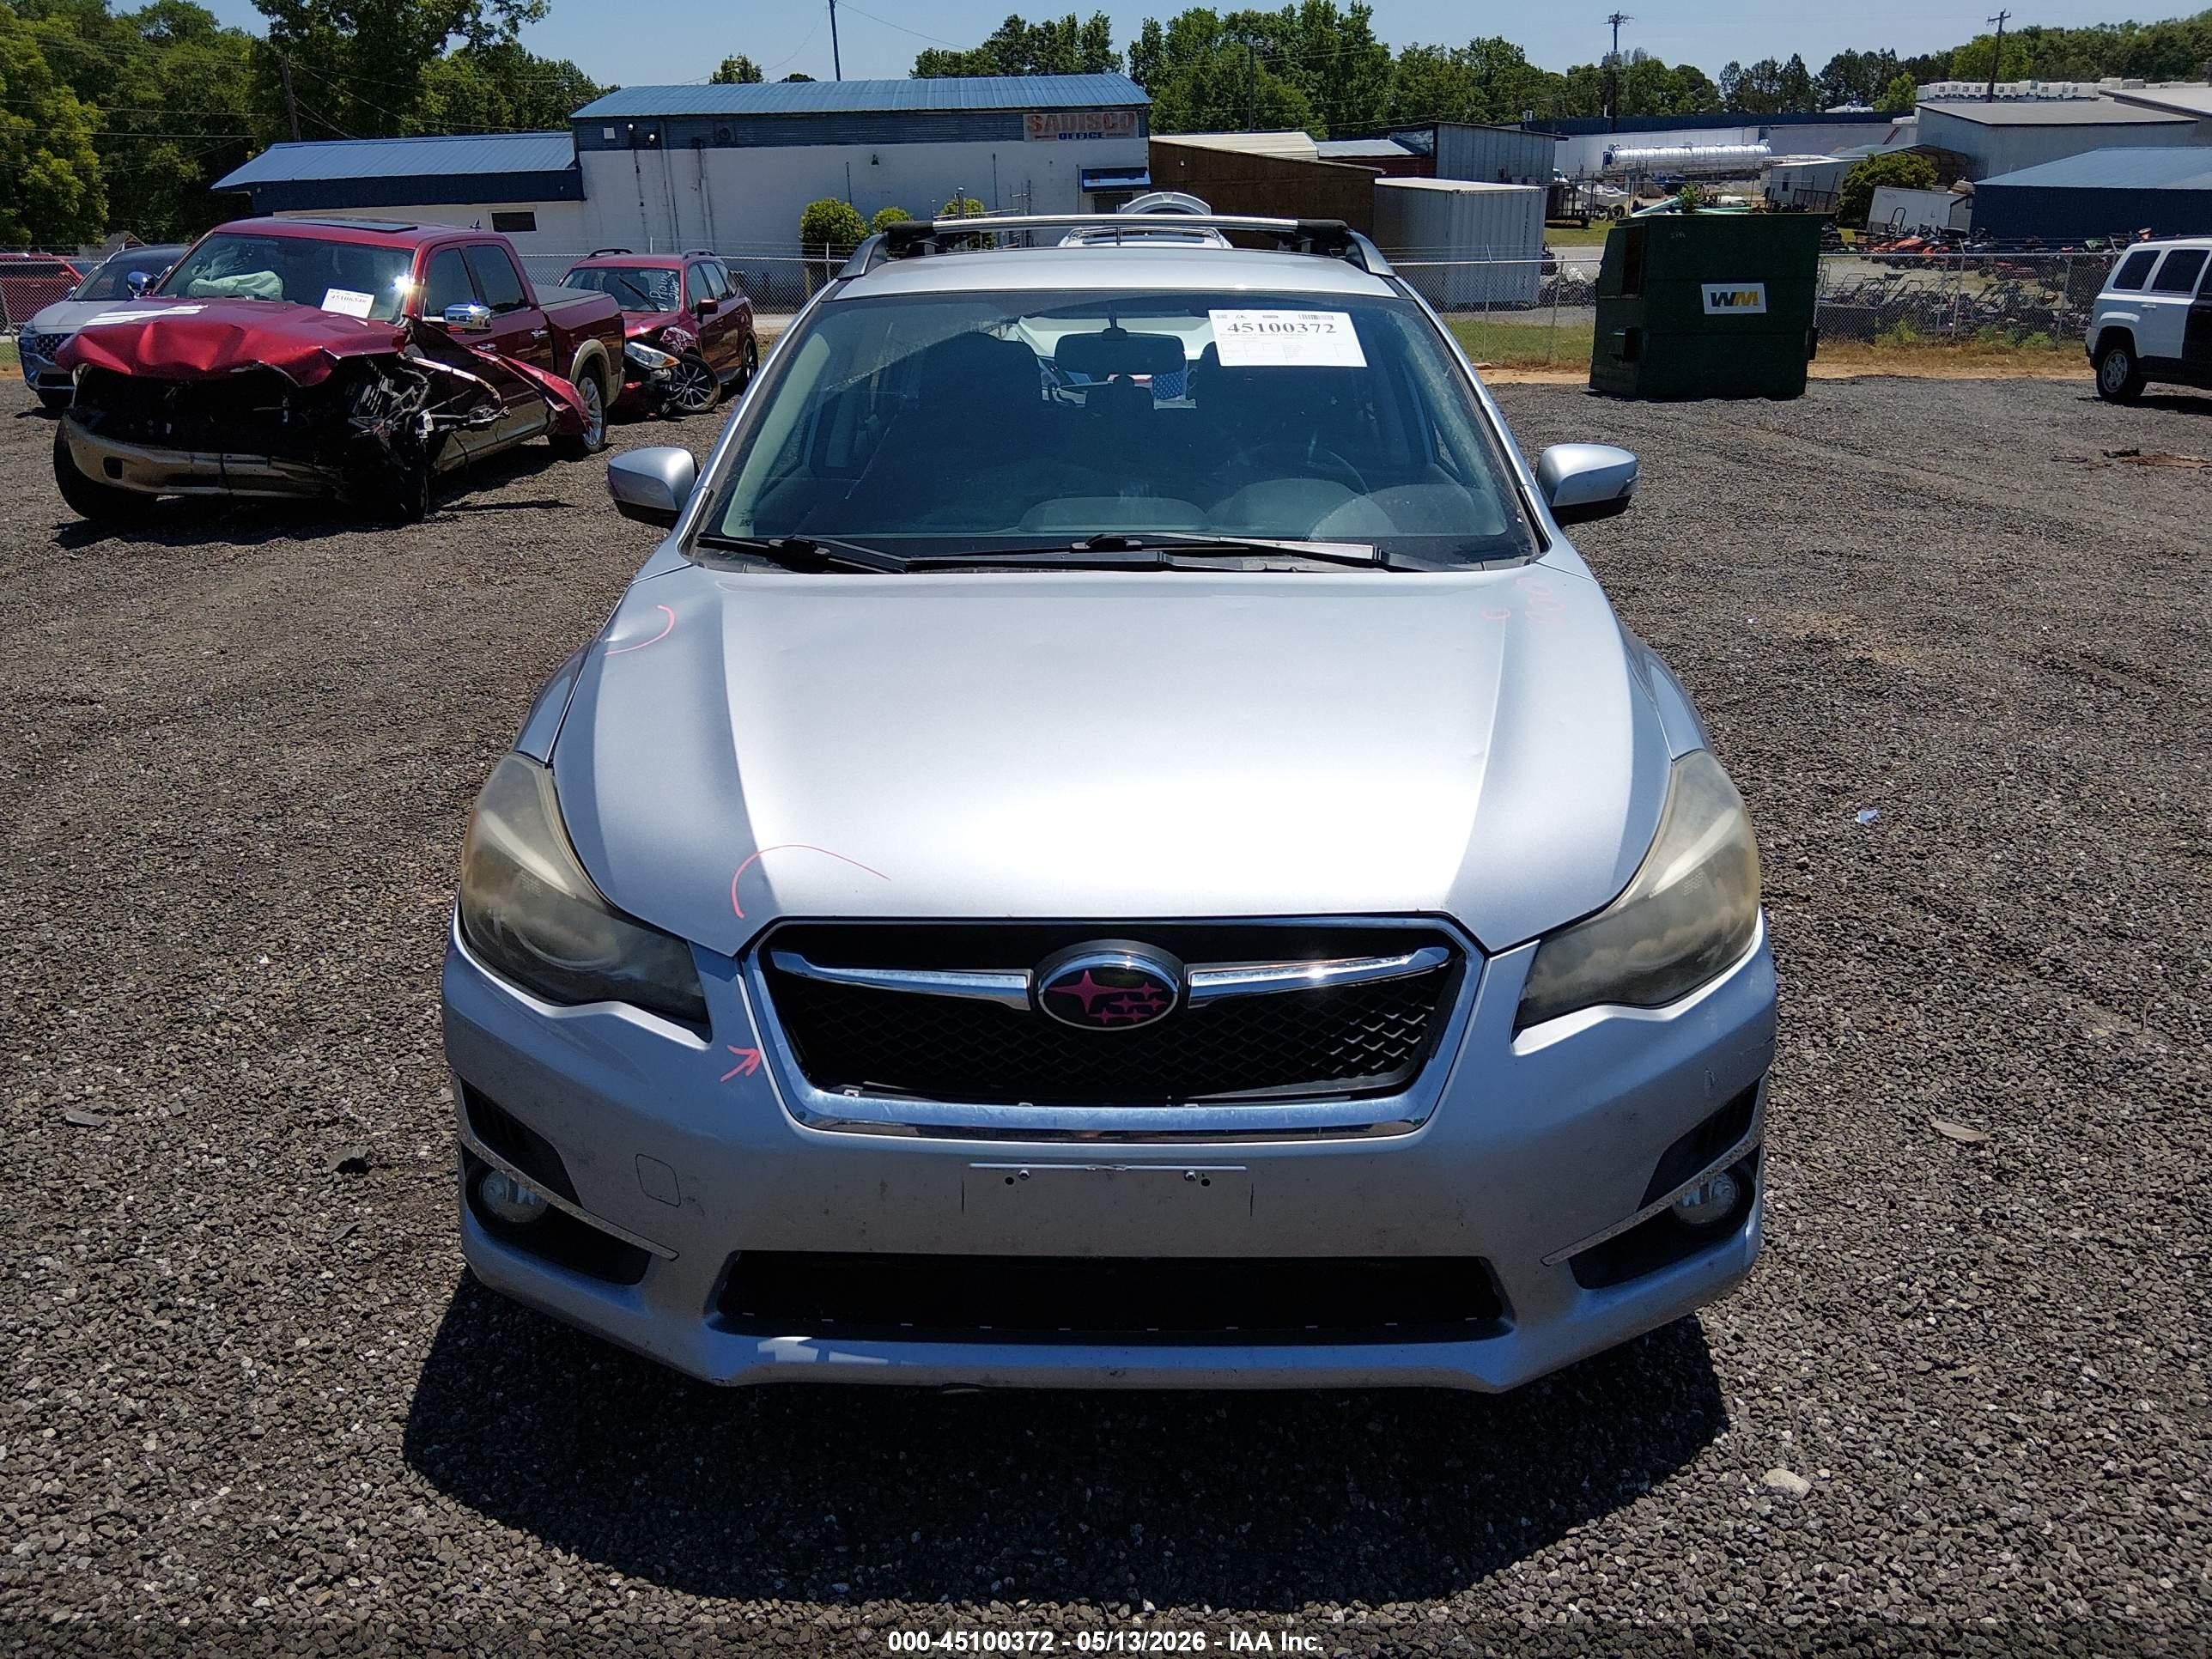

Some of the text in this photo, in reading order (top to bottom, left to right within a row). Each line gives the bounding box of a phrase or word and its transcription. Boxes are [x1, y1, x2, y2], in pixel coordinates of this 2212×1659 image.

[1028, 112, 1135, 131] SADISCO
[1058, 131, 1105, 140] OFFICE
[1711, 291, 1759, 307] WM
[1227, 322, 1337, 334] 45100372
